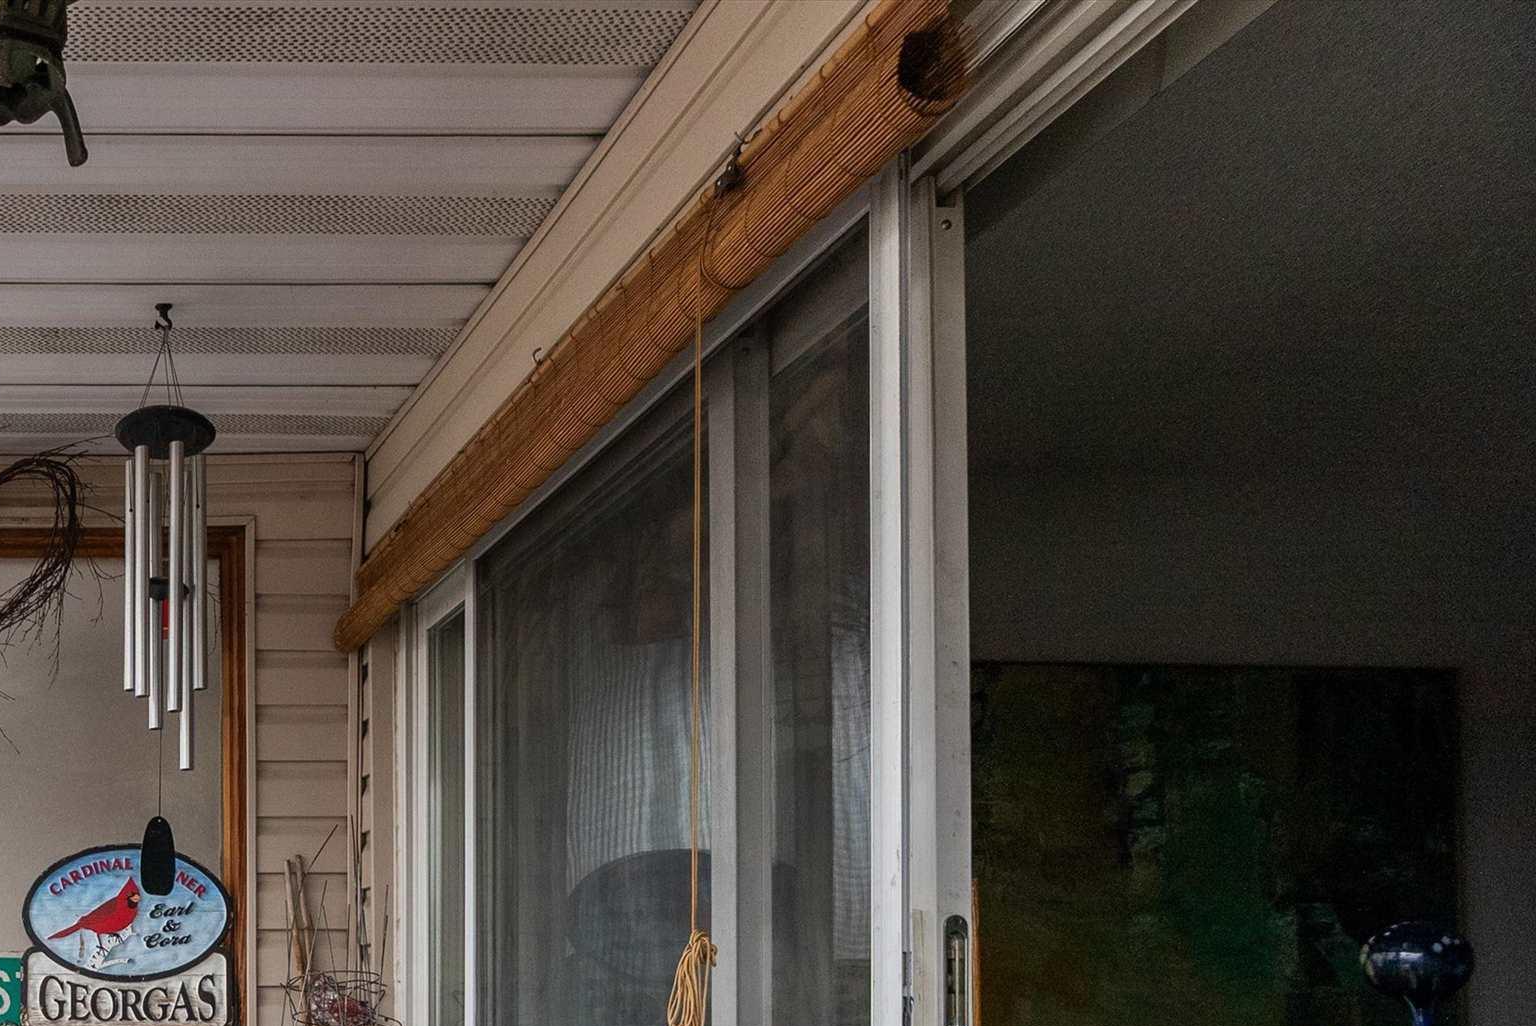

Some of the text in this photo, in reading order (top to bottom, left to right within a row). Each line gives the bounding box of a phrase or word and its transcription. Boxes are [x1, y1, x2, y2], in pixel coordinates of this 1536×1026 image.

[49, 858, 206, 900] CARDINAL NER
[149, 901, 195, 920] Earl
[162, 919, 181, 933] &
[143, 933, 192, 949] Cora
[39, 974, 217, 1023] GEORGAS
